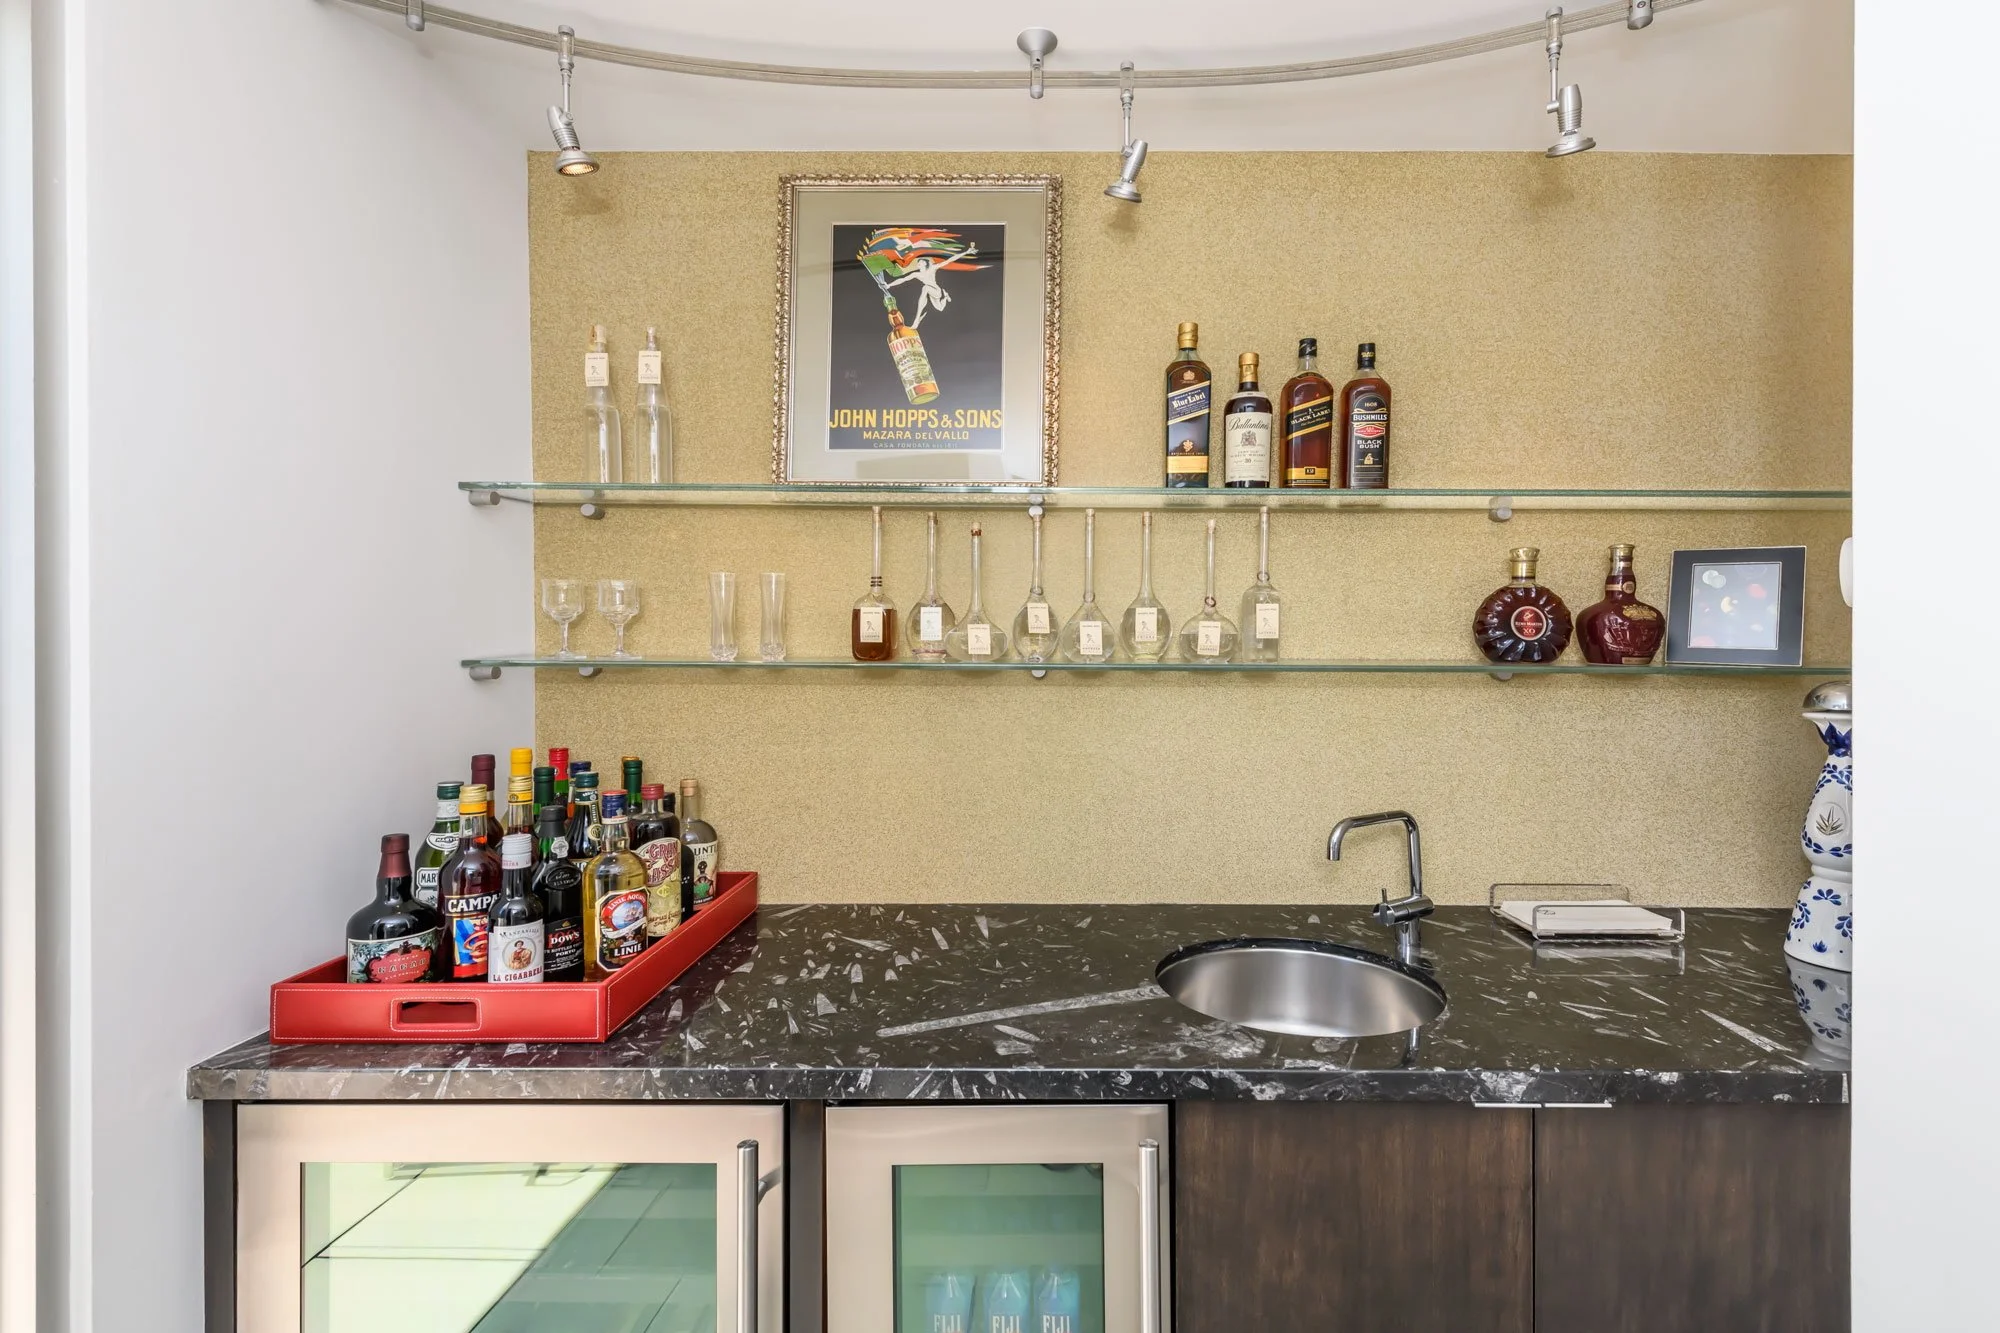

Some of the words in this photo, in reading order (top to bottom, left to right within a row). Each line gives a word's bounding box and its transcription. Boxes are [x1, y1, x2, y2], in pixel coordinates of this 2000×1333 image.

[1172, 399, 1188, 409] Blue
[1187, 392, 1206, 402] Label
[829, 409, 876, 428] JOHN
[882, 409, 938, 428] HOPPS
[941, 414, 952, 428] &
[954, 409, 1002, 428] SONS
[1290, 415, 1312, 425] BLACK
[863, 431, 911, 440] MAZARA
[915, 432, 933, 440] DEL
[934, 431, 969, 440] VALLO
[420, 872, 438, 884] MAR
[447, 893, 501, 913] CAMPA
[607, 896, 627, 911] LINIE
[555, 949, 576, 957] PORTO
[613, 943, 643, 957] LINIE
[493, 974, 501, 982] LA
[933, 1314, 961, 1333] FIJI
[992, 1315, 1020, 1333] FIJI
[1042, 1314, 1070, 1333] FIJI
